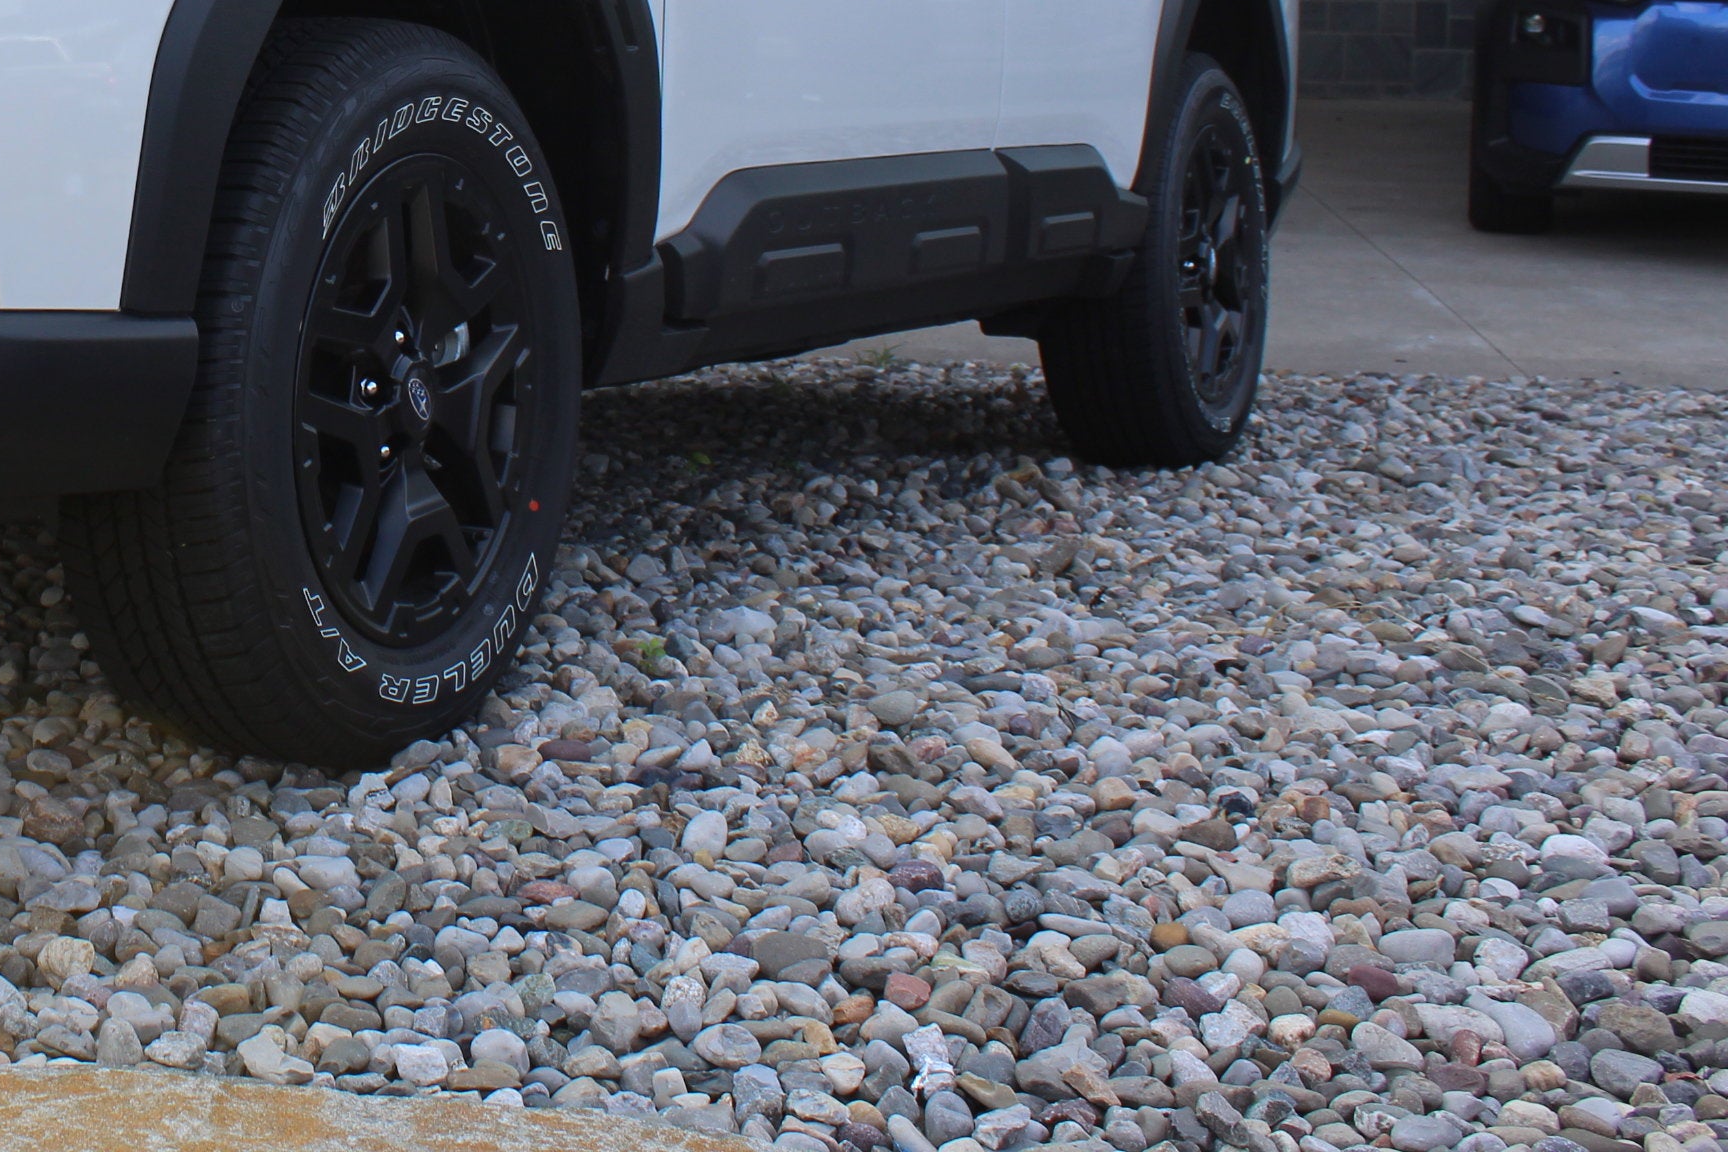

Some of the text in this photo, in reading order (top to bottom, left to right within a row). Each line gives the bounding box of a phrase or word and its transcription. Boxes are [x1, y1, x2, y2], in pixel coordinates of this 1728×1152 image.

[322, 96, 563, 251] BRIDGESTONE
[302, 551, 539, 704] DUELER A/T
